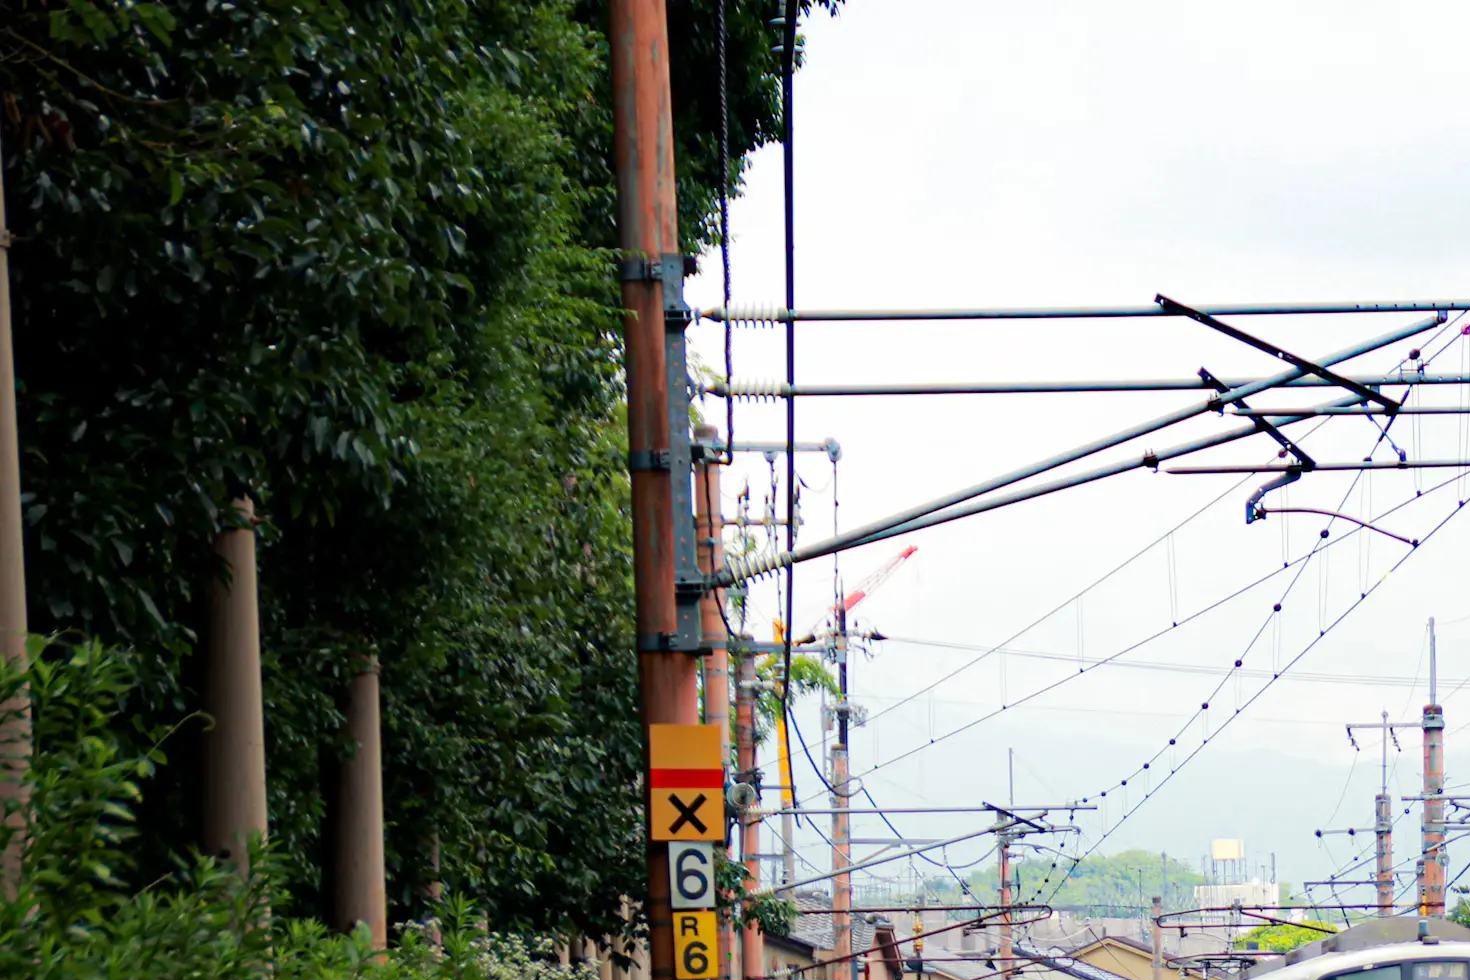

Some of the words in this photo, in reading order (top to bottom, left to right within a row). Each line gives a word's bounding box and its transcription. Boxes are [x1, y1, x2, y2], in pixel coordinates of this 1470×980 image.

[676, 848, 708, 900] 6
[681, 916, 699, 936] R
[683, 941, 708, 975] 6
